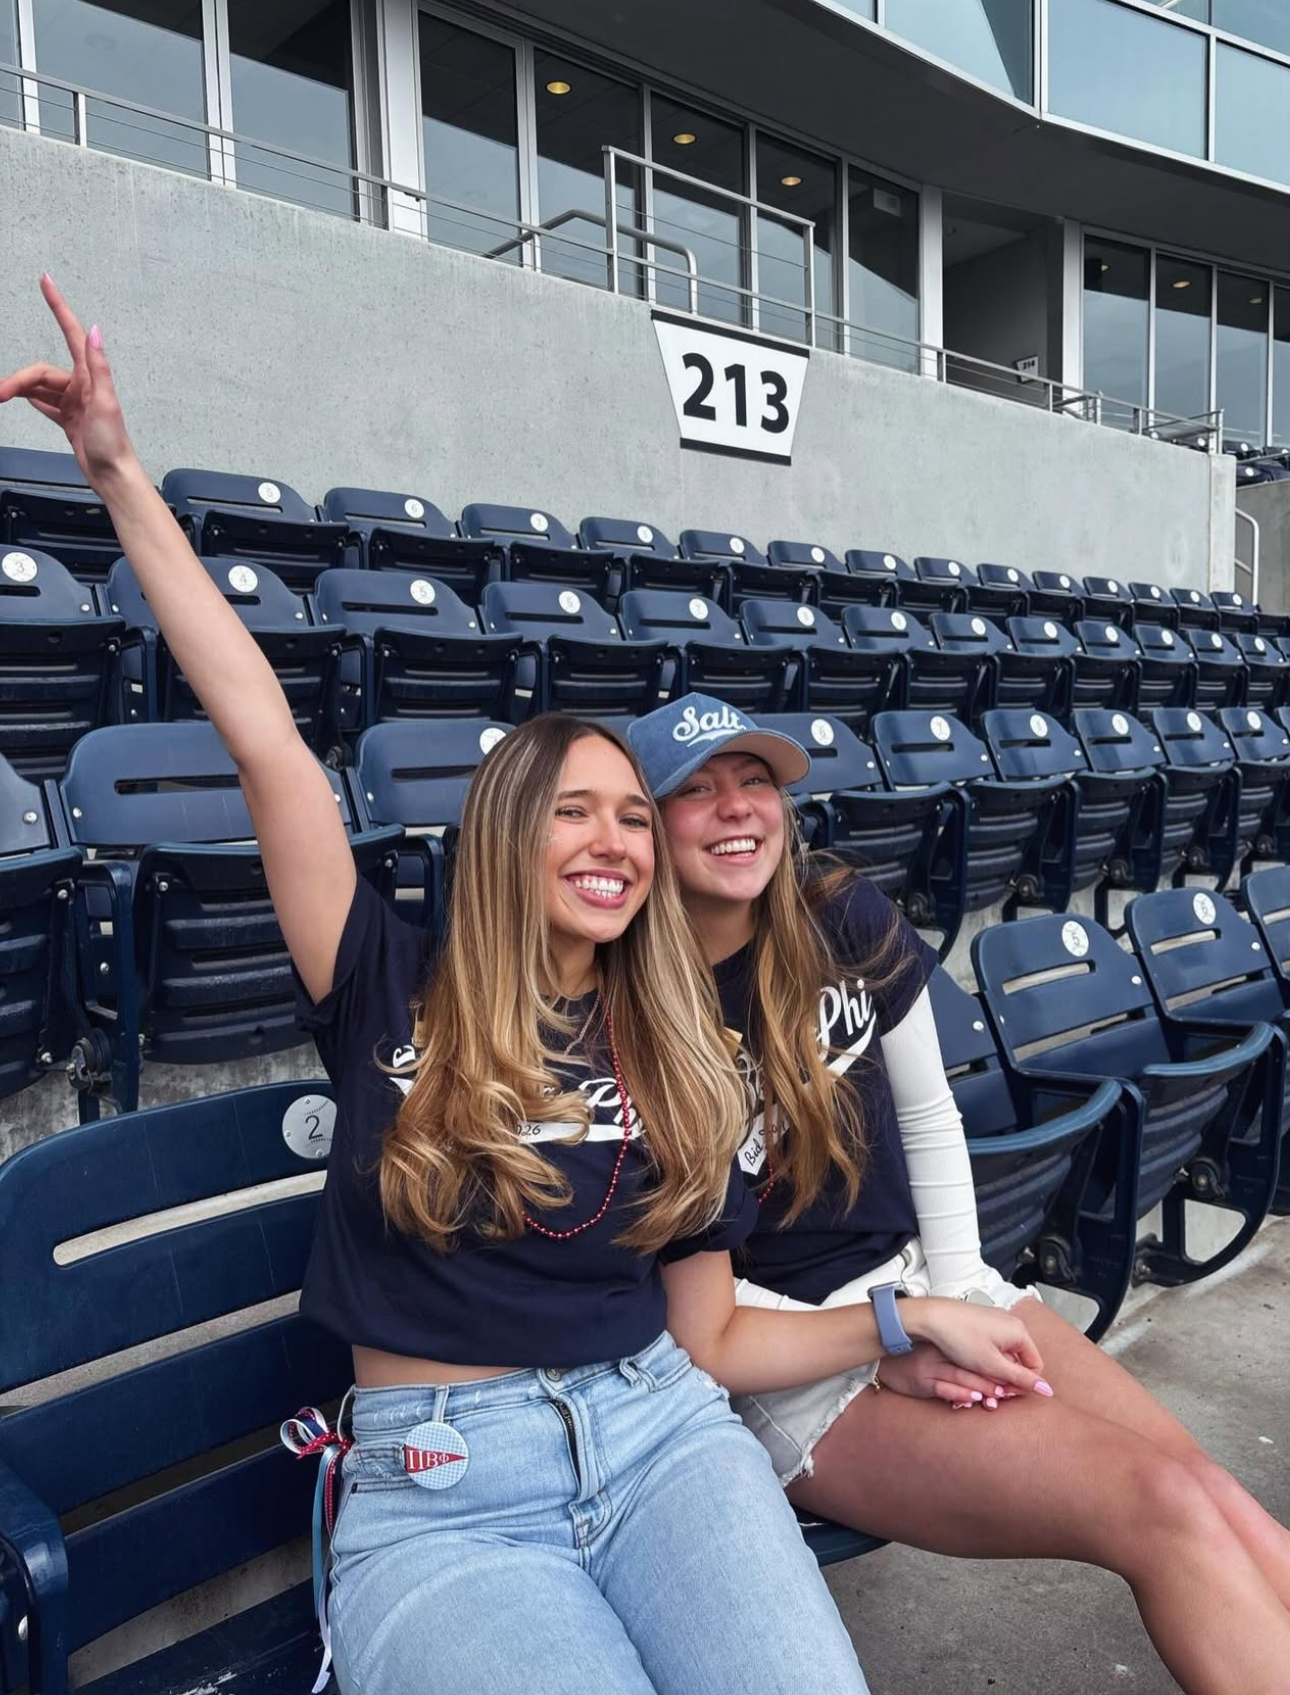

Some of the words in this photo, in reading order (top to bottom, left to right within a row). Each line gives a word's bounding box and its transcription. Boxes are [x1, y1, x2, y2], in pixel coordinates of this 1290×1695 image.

[682, 352, 790, 434] 213
[15, 561, 25, 573] 3
[672, 705, 747, 742] Salt
[1200, 901, 1209, 917] 6
[1071, 931, 1080, 948] 5
[816, 979, 873, 1064] Phi
[305, 1114, 323, 1140] 2
[744, 1138, 764, 1167] Bid
